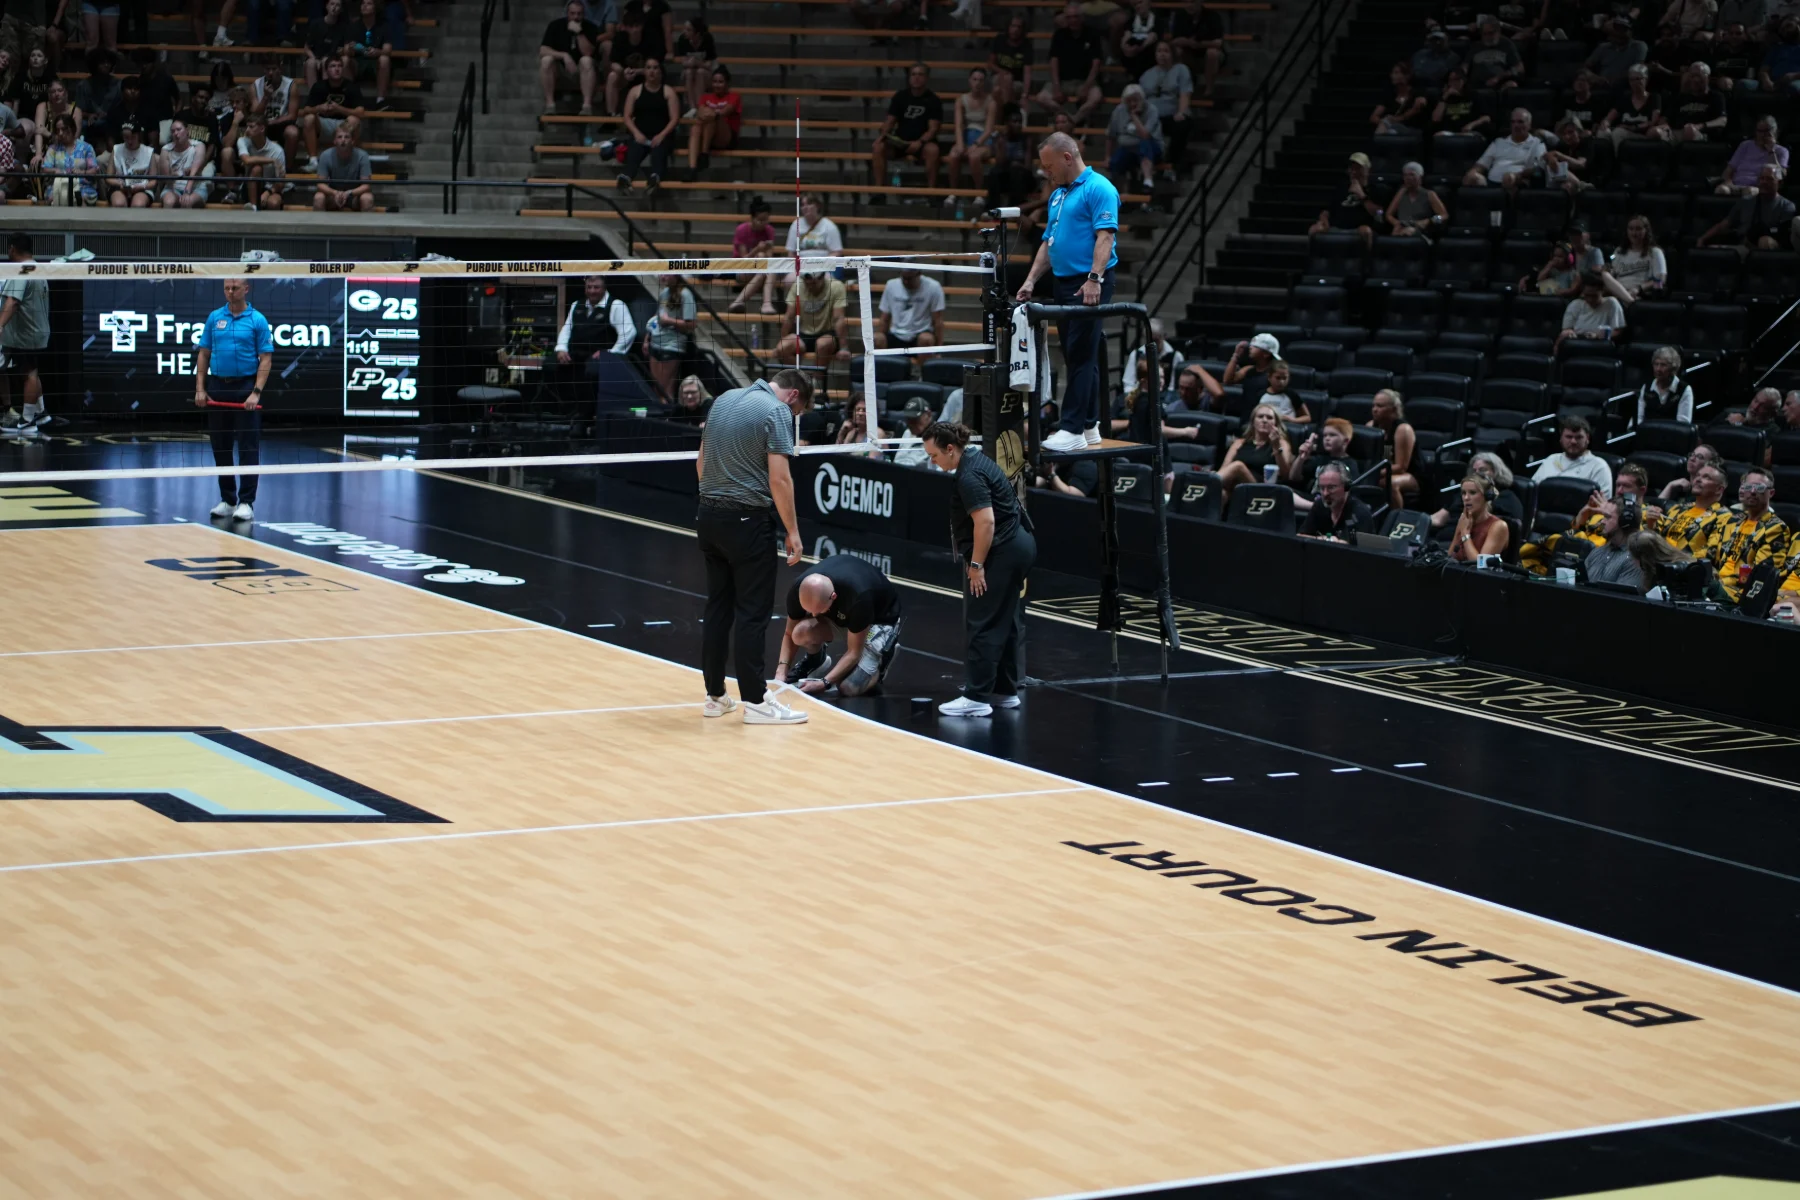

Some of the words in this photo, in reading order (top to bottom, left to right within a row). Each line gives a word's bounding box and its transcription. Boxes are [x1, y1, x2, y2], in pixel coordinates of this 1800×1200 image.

[904, 105, 926, 119] P
[19, 265, 36, 274] P
[87, 264, 128, 275] PURDUE
[133, 263, 194, 274] VOLLEYBALL
[244, 264, 261, 273] P
[310, 263, 342, 274] BOILER
[342, 263, 355, 273] UP
[403, 263, 419, 272] P
[466, 262, 503, 273] PURDUE
[508, 261, 563, 272] VOLLEYBALL
[668, 260, 698, 270] BOILER
[698, 260, 710, 269] UP
[382, 298, 418, 320] 25
[347, 340, 380, 354] 1:15
[346, 367, 385, 391] P
[381, 378, 418, 400] 25
[1000, 392, 1020, 414] P
[1114, 476, 1137, 493] P
[1182, 485, 1207, 501] P
[840, 474, 893, 518] GEMCO
[1246, 498, 1276, 515] P
[1389, 522, 1416, 540] P
[1746, 580, 1764, 599] P
[1059, 840, 1376, 925] COURT
[1354, 929, 1704, 1028] BELIN
